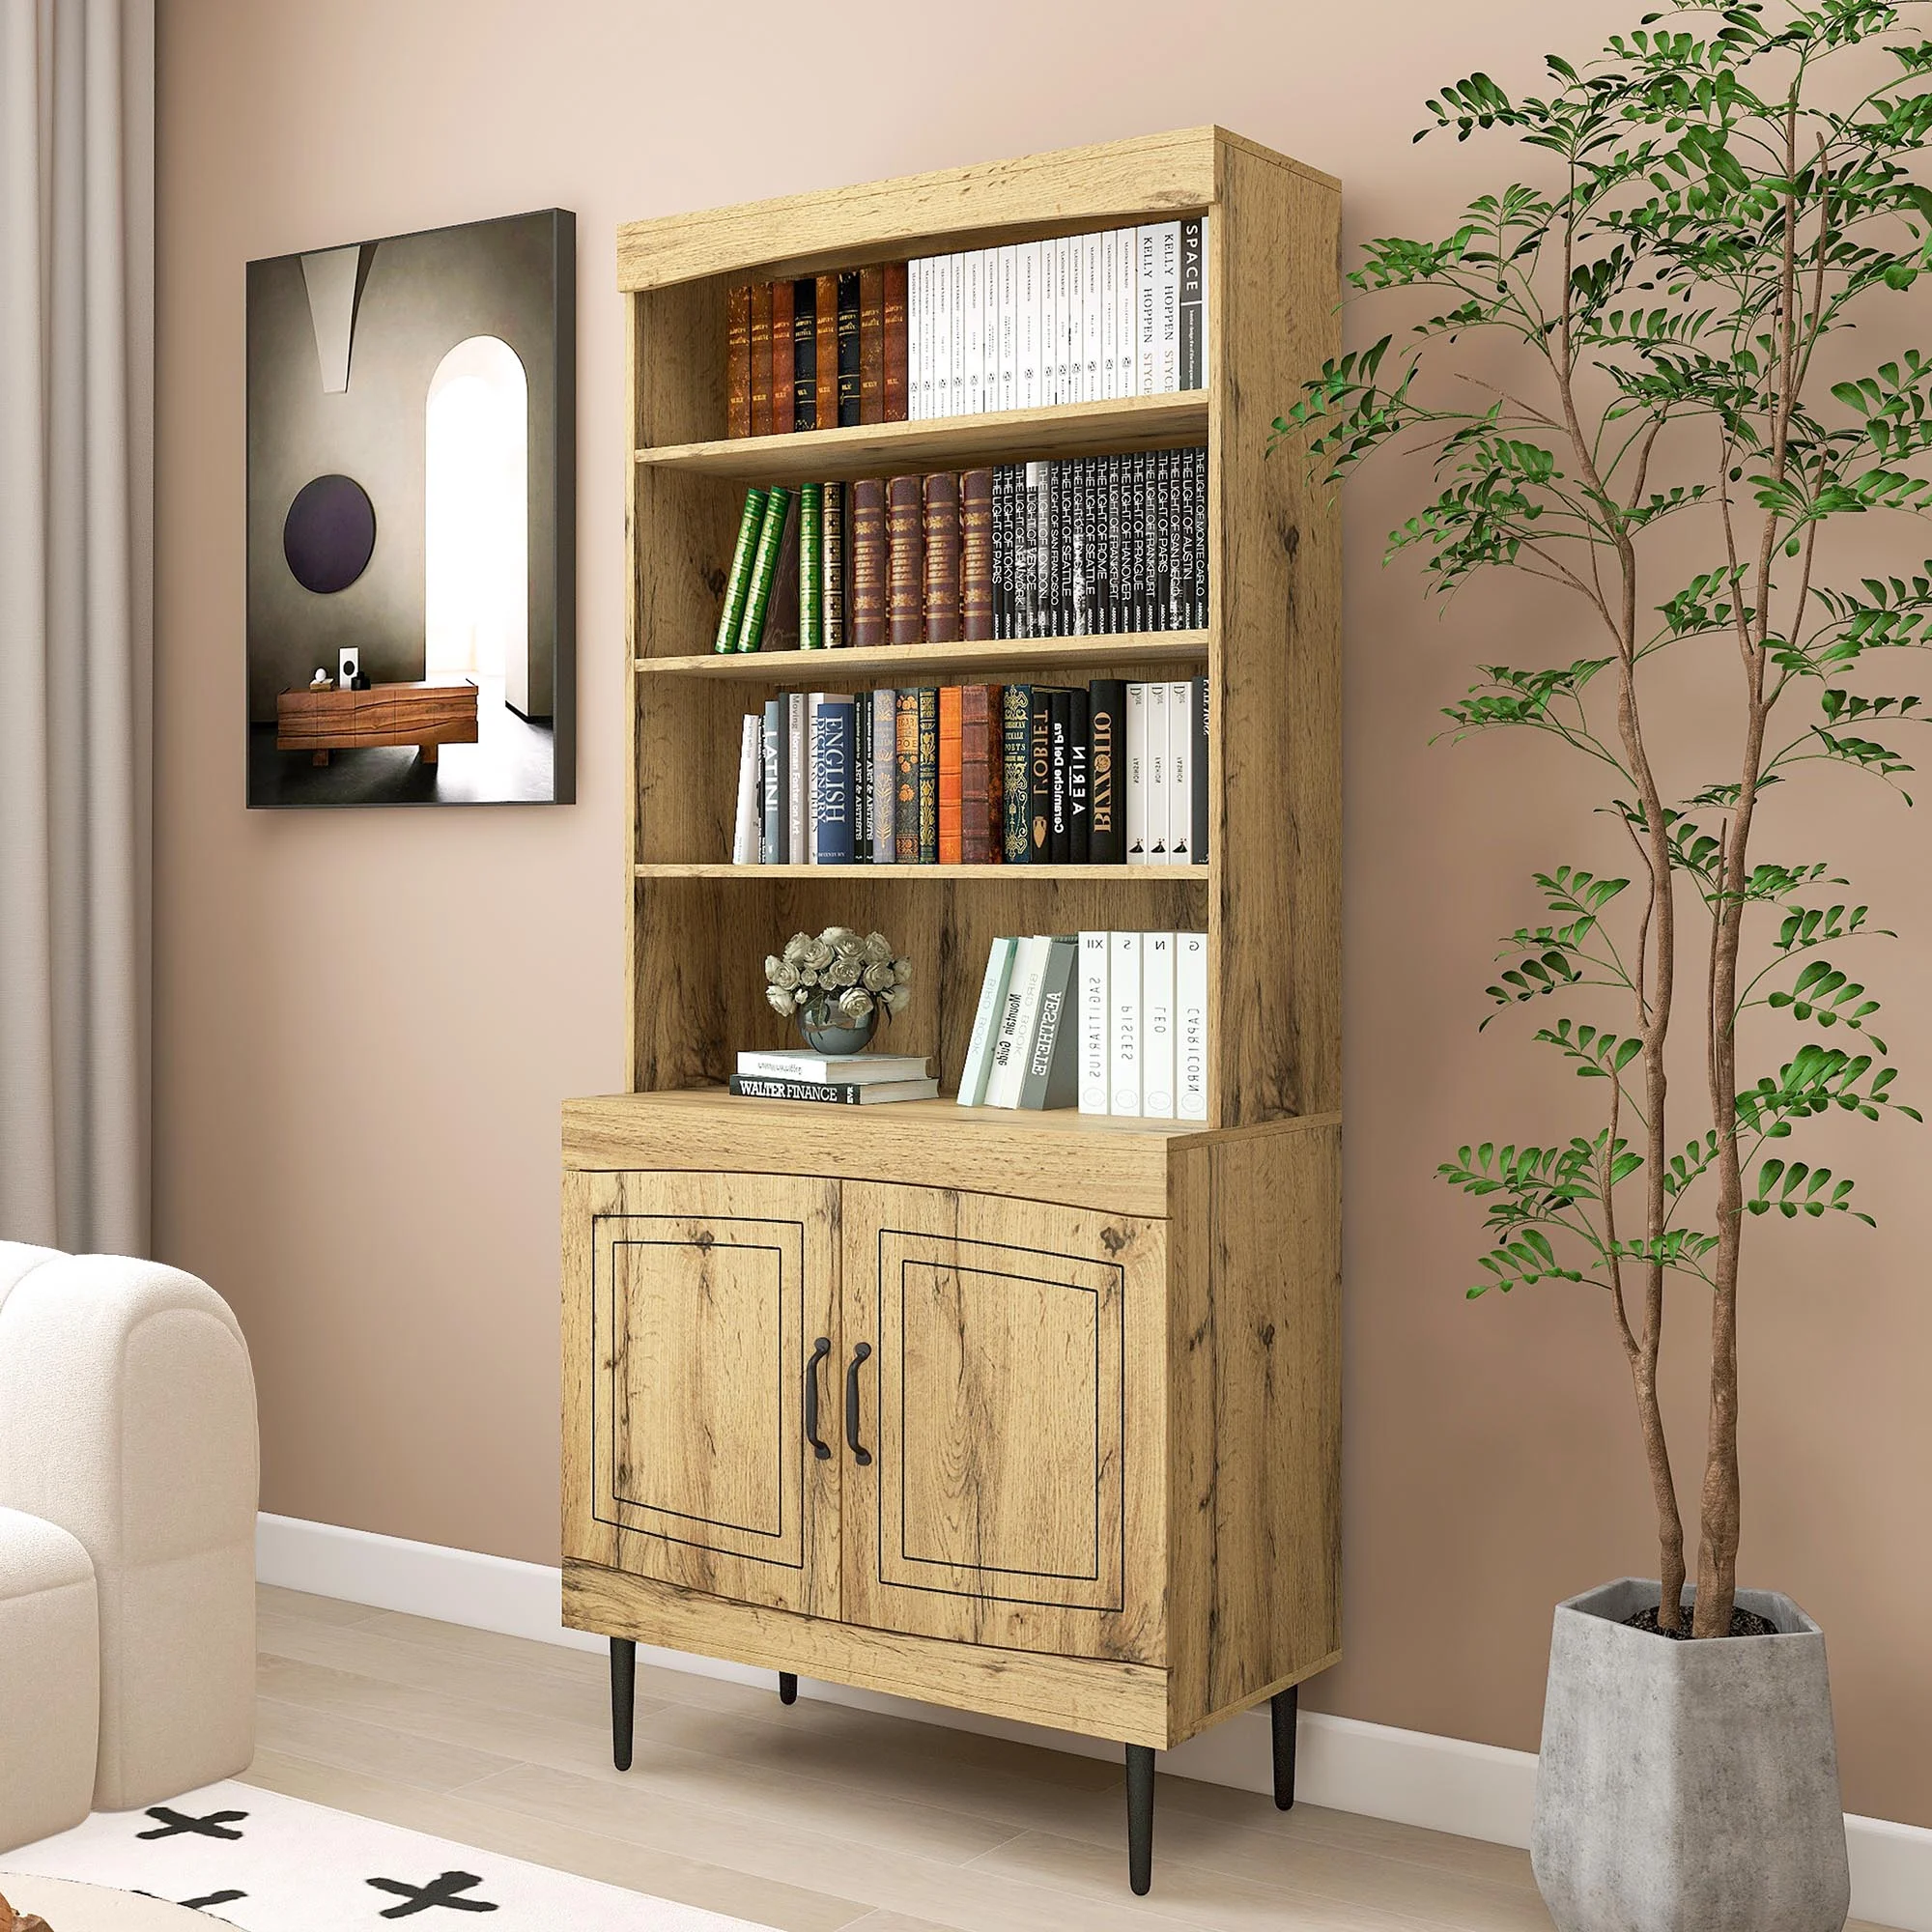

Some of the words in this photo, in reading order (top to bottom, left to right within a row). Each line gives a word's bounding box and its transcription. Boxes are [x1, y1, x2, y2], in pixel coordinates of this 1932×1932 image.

[1144, 237, 1152, 278] KELLY
[1165, 234, 1174, 275] KELLY
[1186, 225, 1198, 291] SPACE
[1144, 288, 1152, 343] HOPPEN
[1165, 286, 1174, 340] HOPPEN
[1062, 465, 1071, 488] THE
[1073, 464, 1082, 483] THE
[1086, 463, 1094, 487] THE
[1097, 462, 1107, 484] THE
[1109, 461, 1119, 482] THE
[1122, 460, 1130, 483] THE
[1133, 458, 1143, 483] THE
[1146, 457, 1155, 479] THE
[1158, 456, 1168, 479] THE
[1171, 455, 1179, 478] THE
[1183, 454, 1193, 478] THE
[1196, 453, 1205, 473] THE
[992, 471, 1002, 496] THE
[1004, 470, 1012, 493] THE
[1015, 469, 1024, 493] THE
[1038, 468, 1048, 490] THE
[1196, 474, 1205, 503] LIGHT
[1015, 494, 1024, 526] LIGHT
[1027, 494, 1036, 527] LIGHT
[1038, 494, 1048, 526] LIGHT
[1062, 491, 1071, 525] LIGHT
[1073, 487, 1082, 517] LIGHT
[1086, 489, 1094, 523] LIGHT
[1097, 488, 1107, 522] LIGHT
[1109, 484, 1119, 515] LIGHT
[1122, 486, 1130, 520] LIGHT
[1133, 485, 1143, 519] LIGHT
[1146, 481, 1155, 513] LIGHT
[1158, 484, 1168, 517] LIGHT
[1171, 480, 1179, 513] LIGHT
[1183, 480, 1193, 515] LIGHT
[992, 497, 1002, 530] LIGHT
[1004, 497, 1012, 528] LIGHT
[1051, 515, 1058, 527] OF
[1073, 519, 1082, 532] OF
[1109, 518, 1119, 532] OF
[1146, 515, 1155, 530] OF
[1171, 515, 1179, 530] OF
[1183, 517, 1193, 533] OF
[1196, 505, 1205, 519] OF
[992, 532, 1002, 549] OF
[1004, 531, 1012, 548] OF
[1015, 527, 1024, 543] OF
[1027, 529, 1036, 545] OF
[1038, 528, 1048, 545] OF
[1062, 526, 1071, 543] OF
[1086, 525, 1094, 541] OF
[1097, 524, 1107, 540] OF
[1122, 522, 1130, 539] OF
[1133, 521, 1143, 537] OF
[1158, 519, 1168, 536] OF
[1196, 522, 1205, 558] MONTE
[1158, 539, 1168, 573] PARIS
[1171, 532, 1179, 557] SAN
[1183, 537, 1193, 579] AUSTIN
[992, 551, 1002, 583] PARIS
[1004, 550, 1012, 591] TOKYO
[1027, 548, 1036, 589] VENICE
[1038, 548, 1048, 598] LONDON
[1062, 546, 1071, 596] SEATTLE
[1086, 544, 1094, 594] SEATTLE
[1097, 543, 1107, 579] ROME
[1109, 535, 1119, 600] FRANKFURT
[1122, 541, 1130, 600] HANOVER
[1133, 540, 1143, 590] PRAGUE
[1146, 532, 1155, 597] FRANKFURT
[1015, 574, 1024, 606] YORK
[1196, 560, 1205, 596] CARLO
[791, 696, 800, 729] Moving
[765, 731, 778, 805] LATIN
[817, 717, 826, 823] DICTIONARY
[825, 716, 844, 823] ENGLISH
[856, 784, 862, 794] &
[867, 784, 873, 794] &
[792, 806, 798, 816] on
[739, 1080, 786, 1098] WALTER
[786, 1084, 838, 1101] FINANCE
